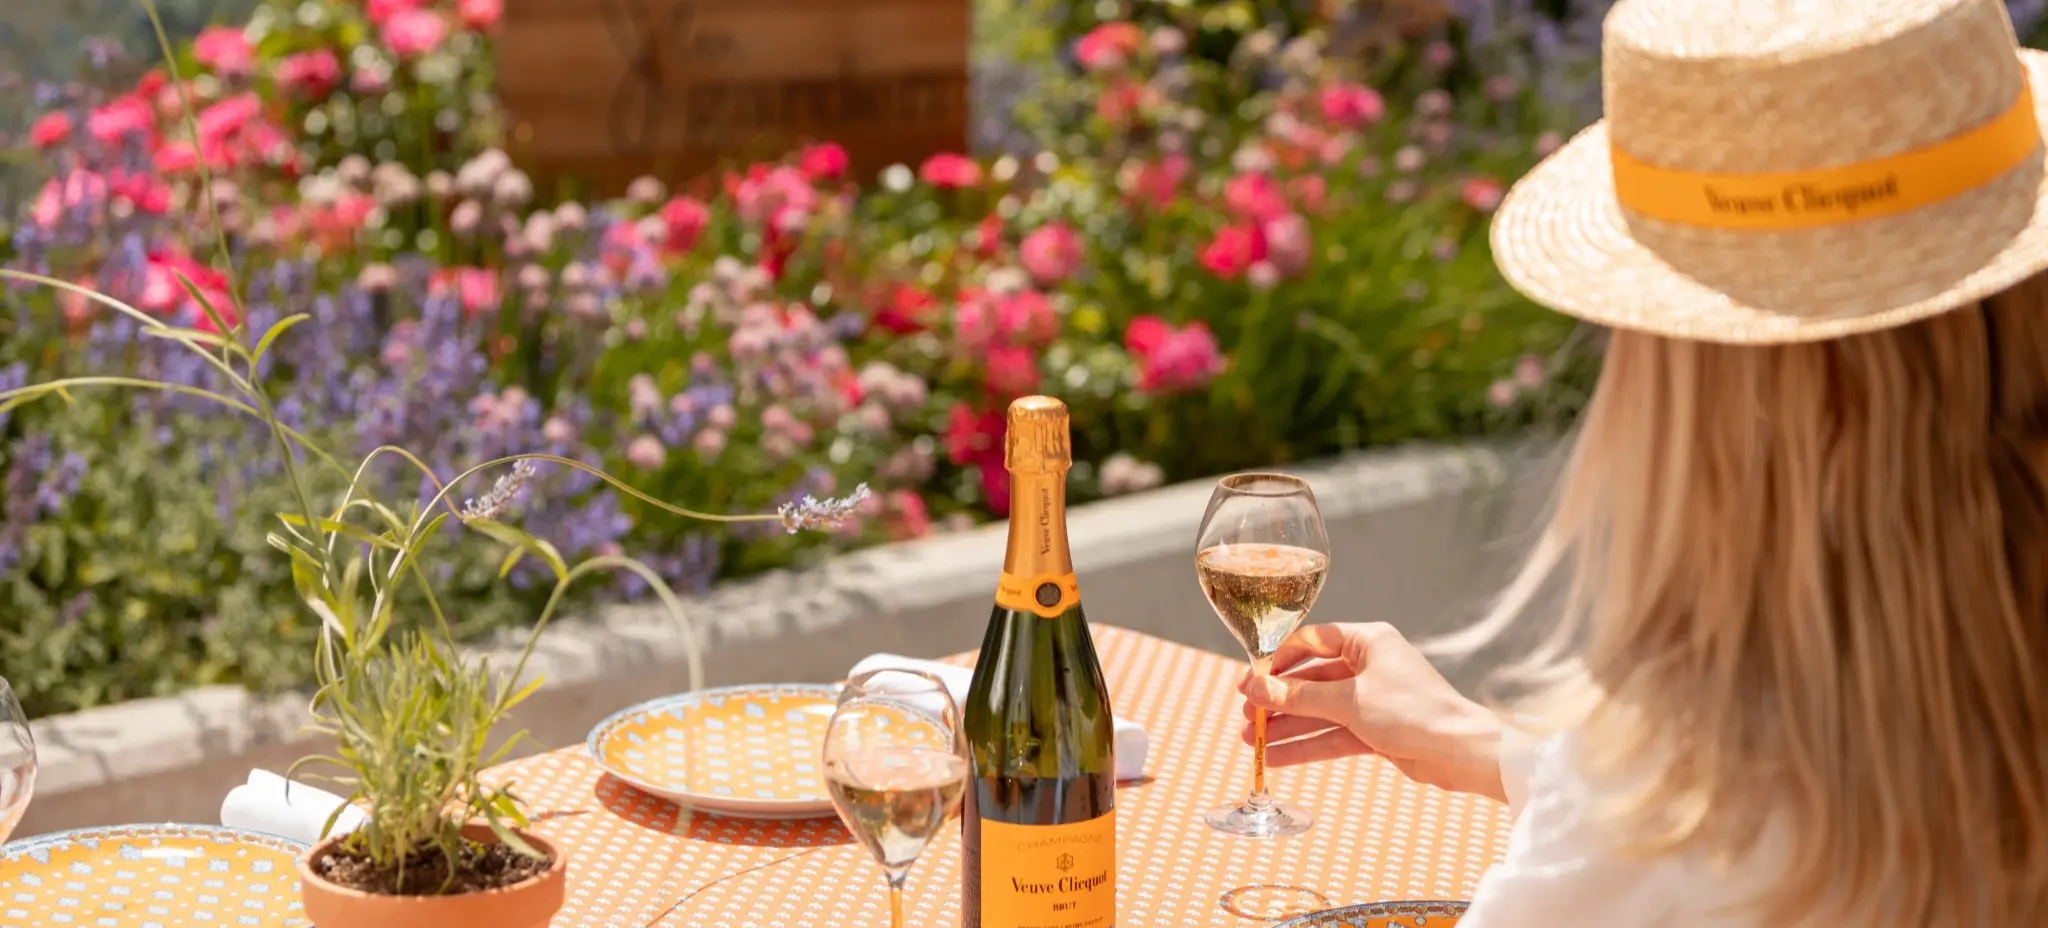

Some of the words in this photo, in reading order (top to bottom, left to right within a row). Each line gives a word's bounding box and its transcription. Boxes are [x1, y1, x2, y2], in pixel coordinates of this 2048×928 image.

[1040, 488, 1051, 527] Clicquot
[1041, 528, 1051, 556] Veuve
[1017, 833, 1103, 852] CHAMPAGNE
[1011, 876, 1054, 894] Veuve
[1058, 870, 1107, 894] Clicquot
[1052, 901, 1077, 912] BRUT
